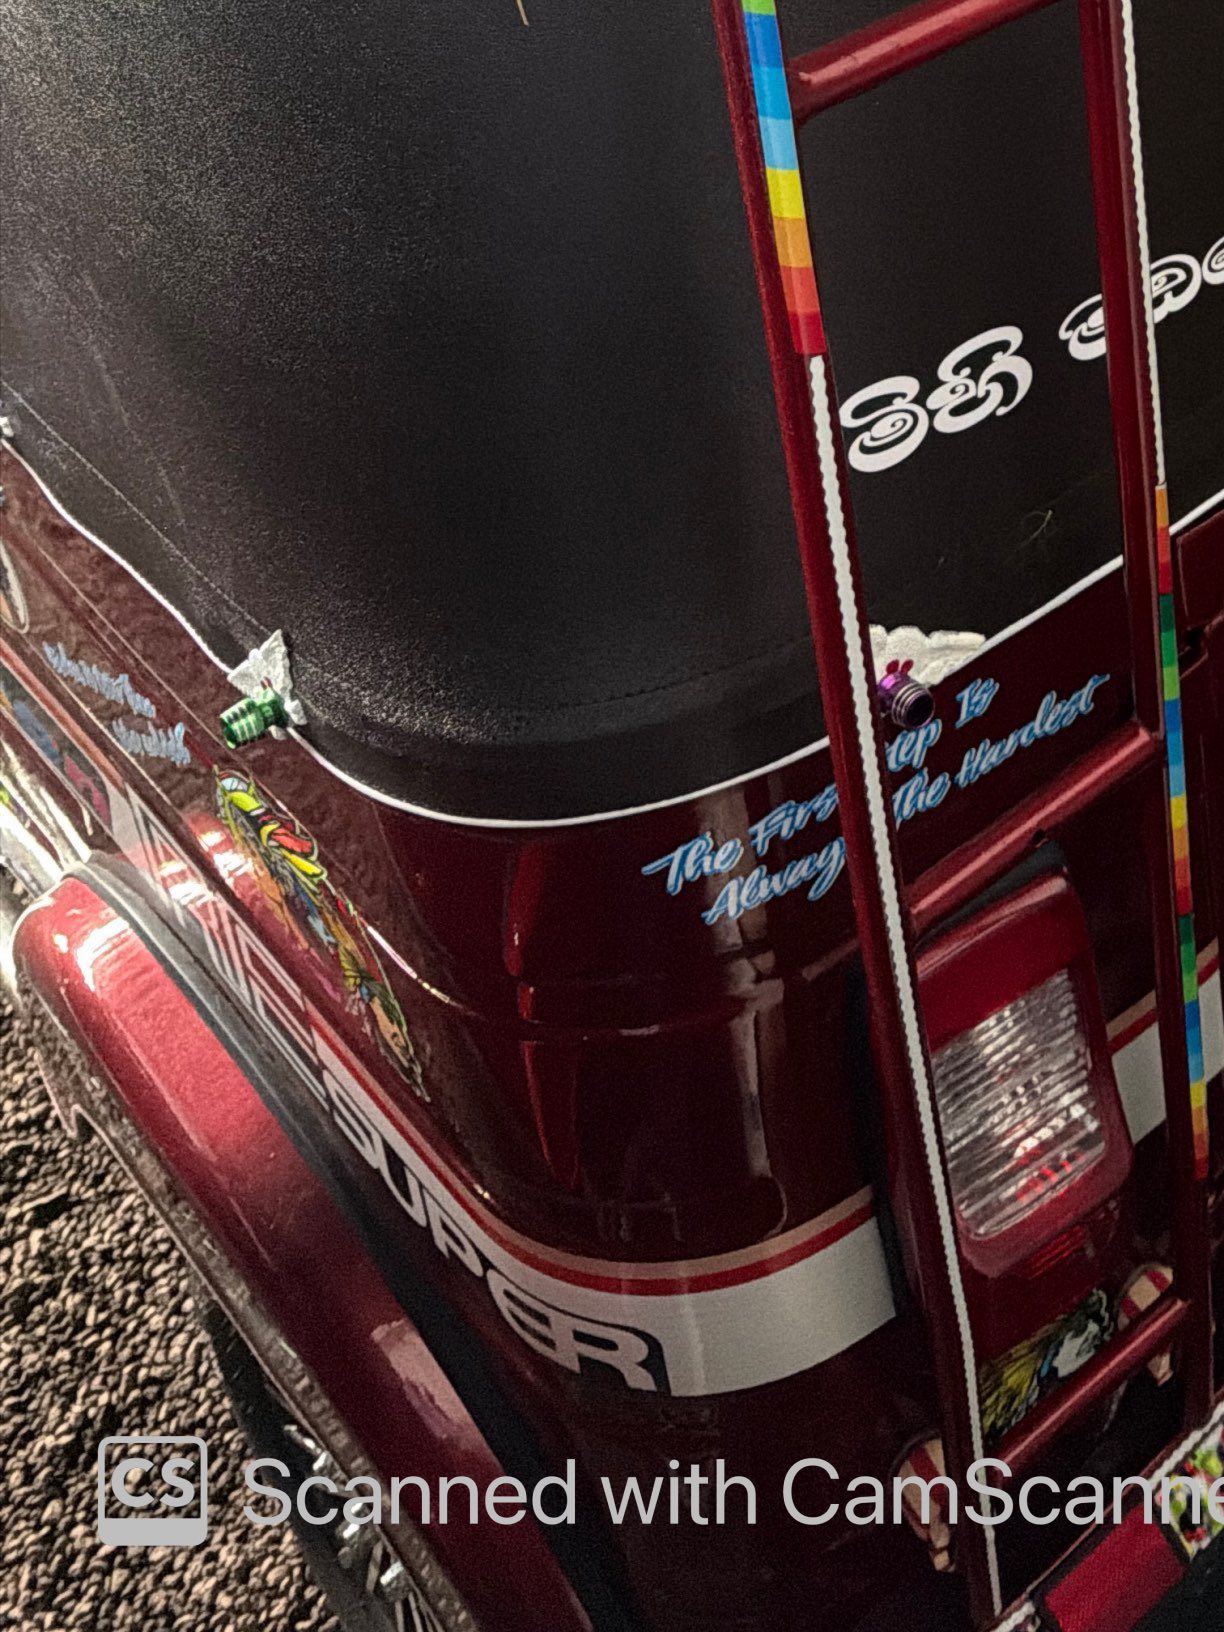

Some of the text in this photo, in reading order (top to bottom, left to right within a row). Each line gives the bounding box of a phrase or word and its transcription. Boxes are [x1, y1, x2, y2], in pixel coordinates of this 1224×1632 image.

[642, 830, 744, 896] The
[748, 781, 839, 858] Firs
[884, 718, 942, 772] tep
[701, 834, 847, 926] Alway
[953, 673, 1110, 790] Hardest
